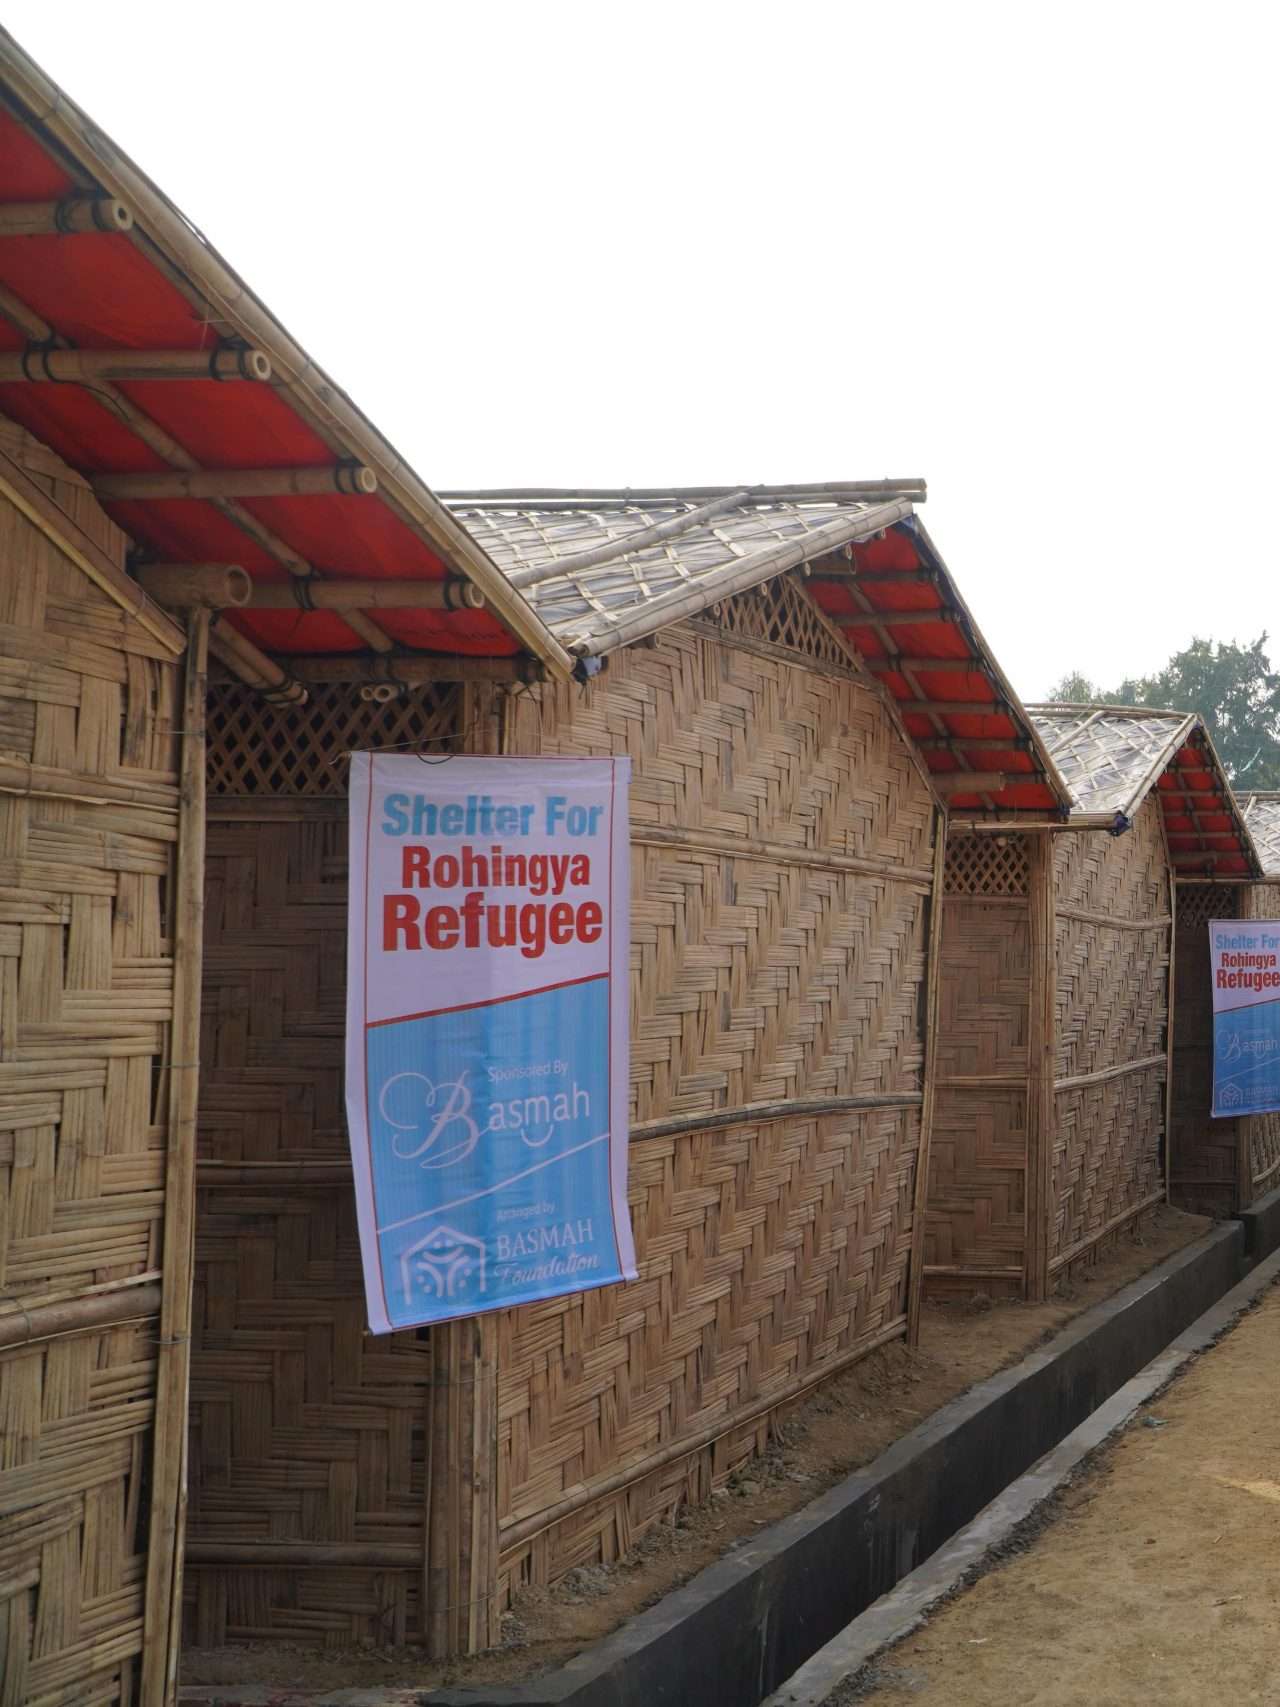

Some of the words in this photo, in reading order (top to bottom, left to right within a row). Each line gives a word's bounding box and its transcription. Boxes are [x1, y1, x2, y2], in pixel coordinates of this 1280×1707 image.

[381, 793, 536, 836] Shelter
[545, 796, 603, 836] For
[402, 845, 590, 896] Rohingya
[383, 892, 603, 958] Refugee
[1215, 934, 1258, 949] Shelter
[1261, 934, 1280, 948] For
[1216, 968, 1280, 991] Refugee
[1221, 952, 1276, 969] Rohingya
[497, 1218, 594, 1260] BASMAH
[494, 1252, 600, 1286] Foundation
